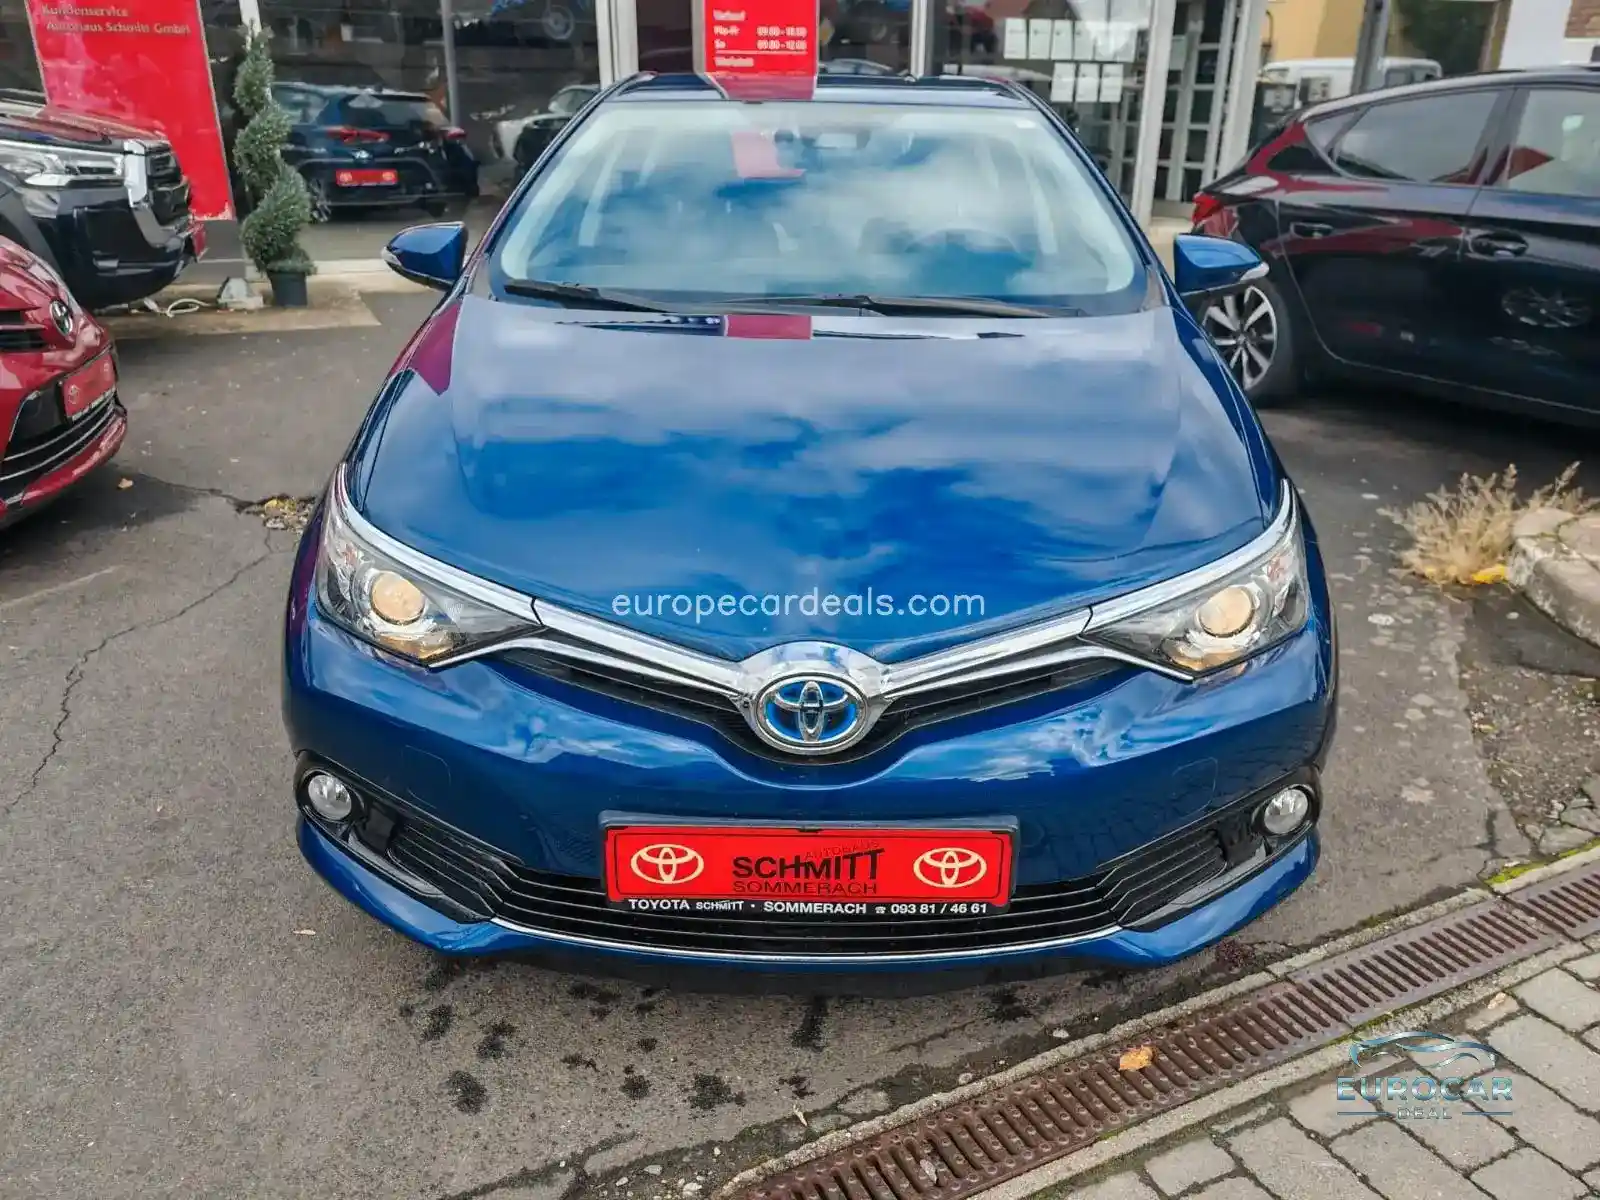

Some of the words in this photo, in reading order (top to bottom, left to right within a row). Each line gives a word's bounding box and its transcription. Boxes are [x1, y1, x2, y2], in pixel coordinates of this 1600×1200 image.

[805, 839, 880, 860] AUTOHAUS
[732, 848, 885, 880] SCHMITT
[732, 880, 878, 895] SOMMERACH
[628, 898, 690, 910] TOYOTA
[695, 900, 744, 911] SCHMITT
[763, 901, 867, 914] SOMMERACH
[890, 903, 917, 914] 093
[919, 903, 936, 914] 81
[950, 903, 967, 914] 46
[970, 903, 987, 913] 61
